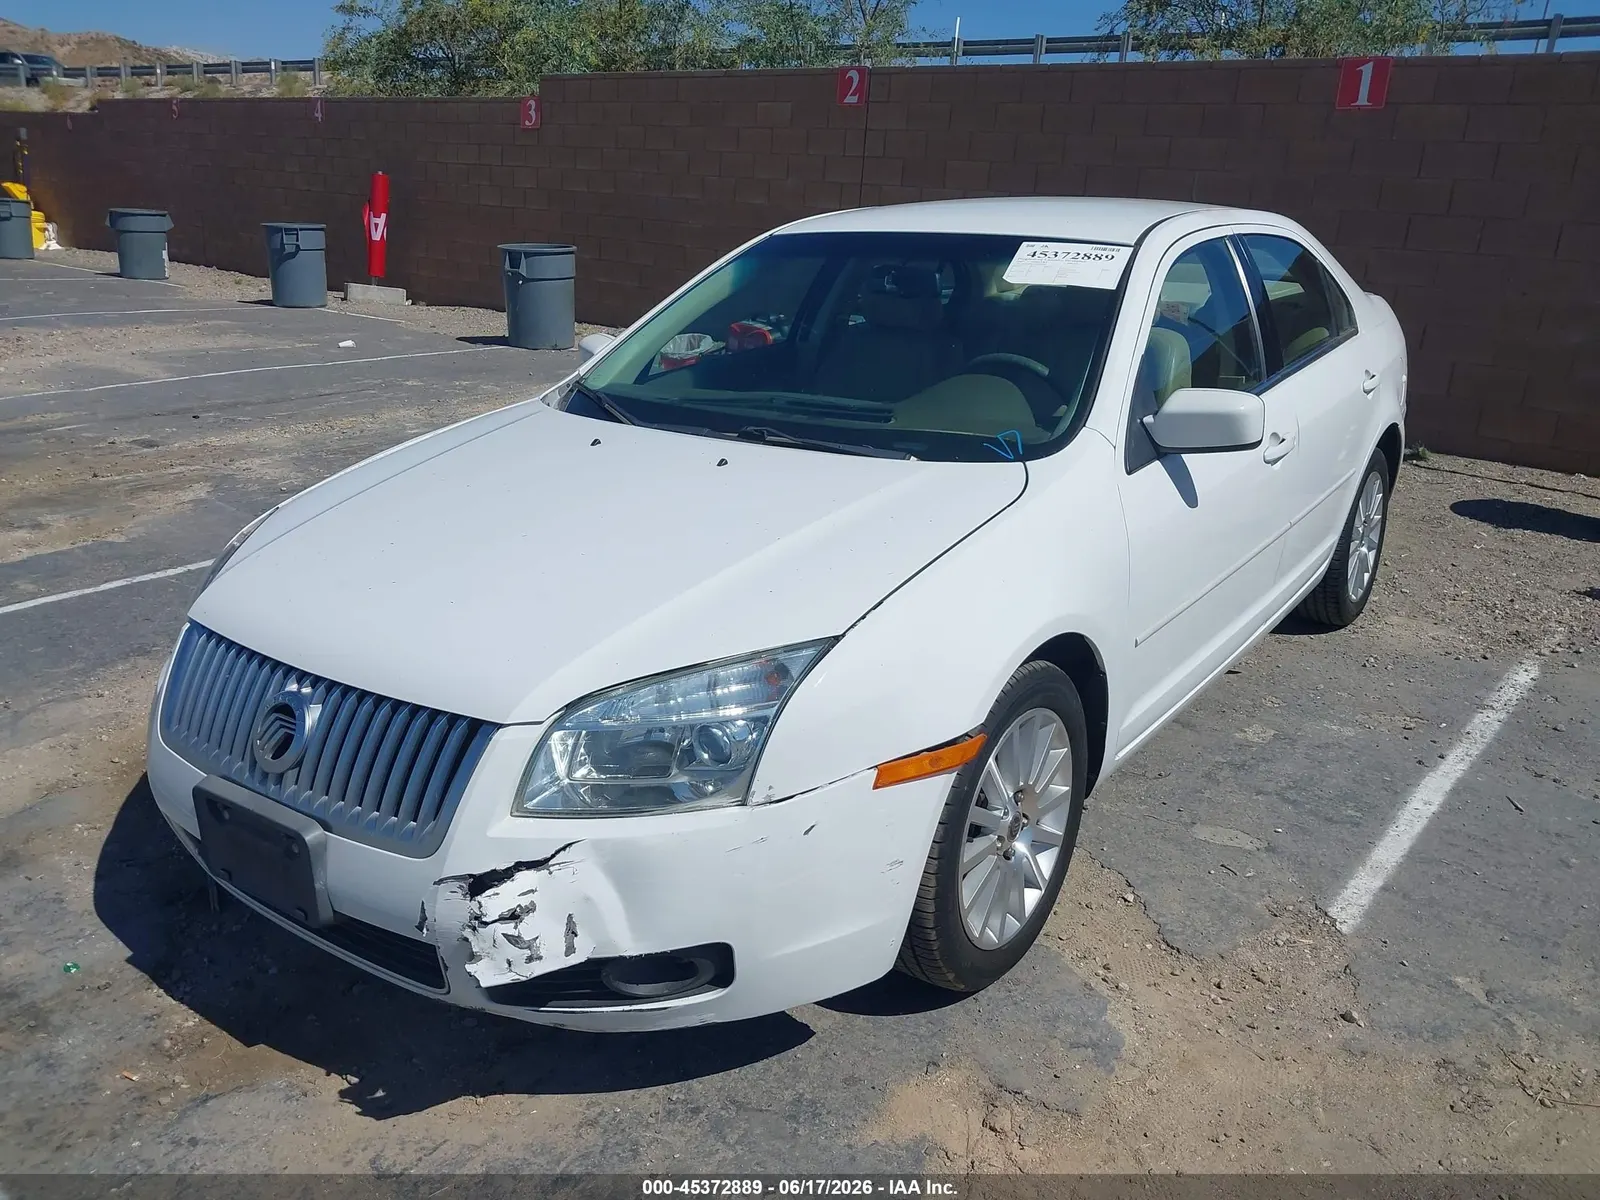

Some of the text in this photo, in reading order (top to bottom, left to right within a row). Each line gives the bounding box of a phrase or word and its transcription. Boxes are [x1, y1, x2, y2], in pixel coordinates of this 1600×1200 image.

[843, 69, 860, 103] 2
[1350, 61, 1374, 106] 1
[172, 99, 179, 120] 5
[314, 99, 323, 122] 4
[525, 99, 536, 126] 3
[1026, 250, 1115, 262] 45372889
